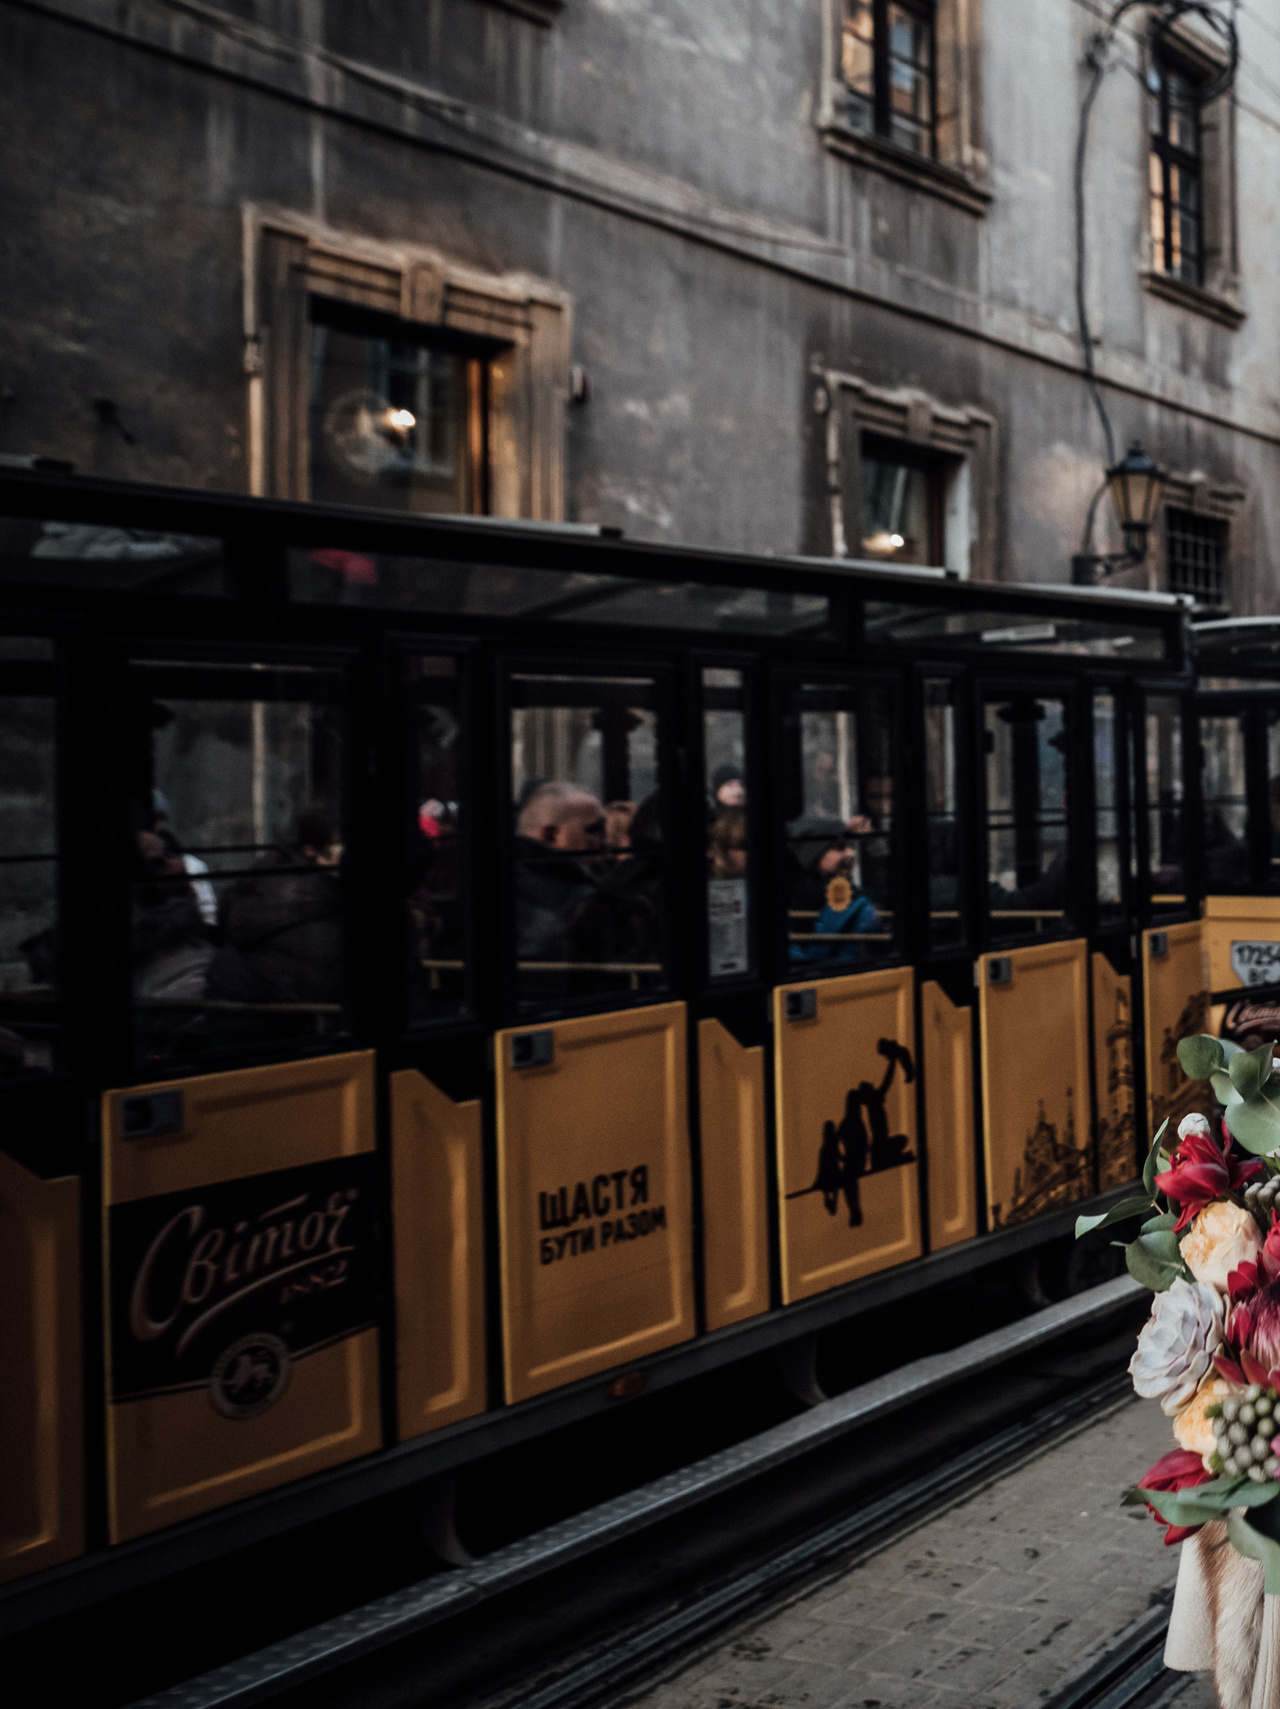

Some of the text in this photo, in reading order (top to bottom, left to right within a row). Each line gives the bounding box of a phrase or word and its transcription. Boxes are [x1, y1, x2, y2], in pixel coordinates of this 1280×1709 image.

[539, 1164, 648, 1231] ЩАСТЯ
[540, 1205, 667, 1266] БУТИ РАЗОМ
